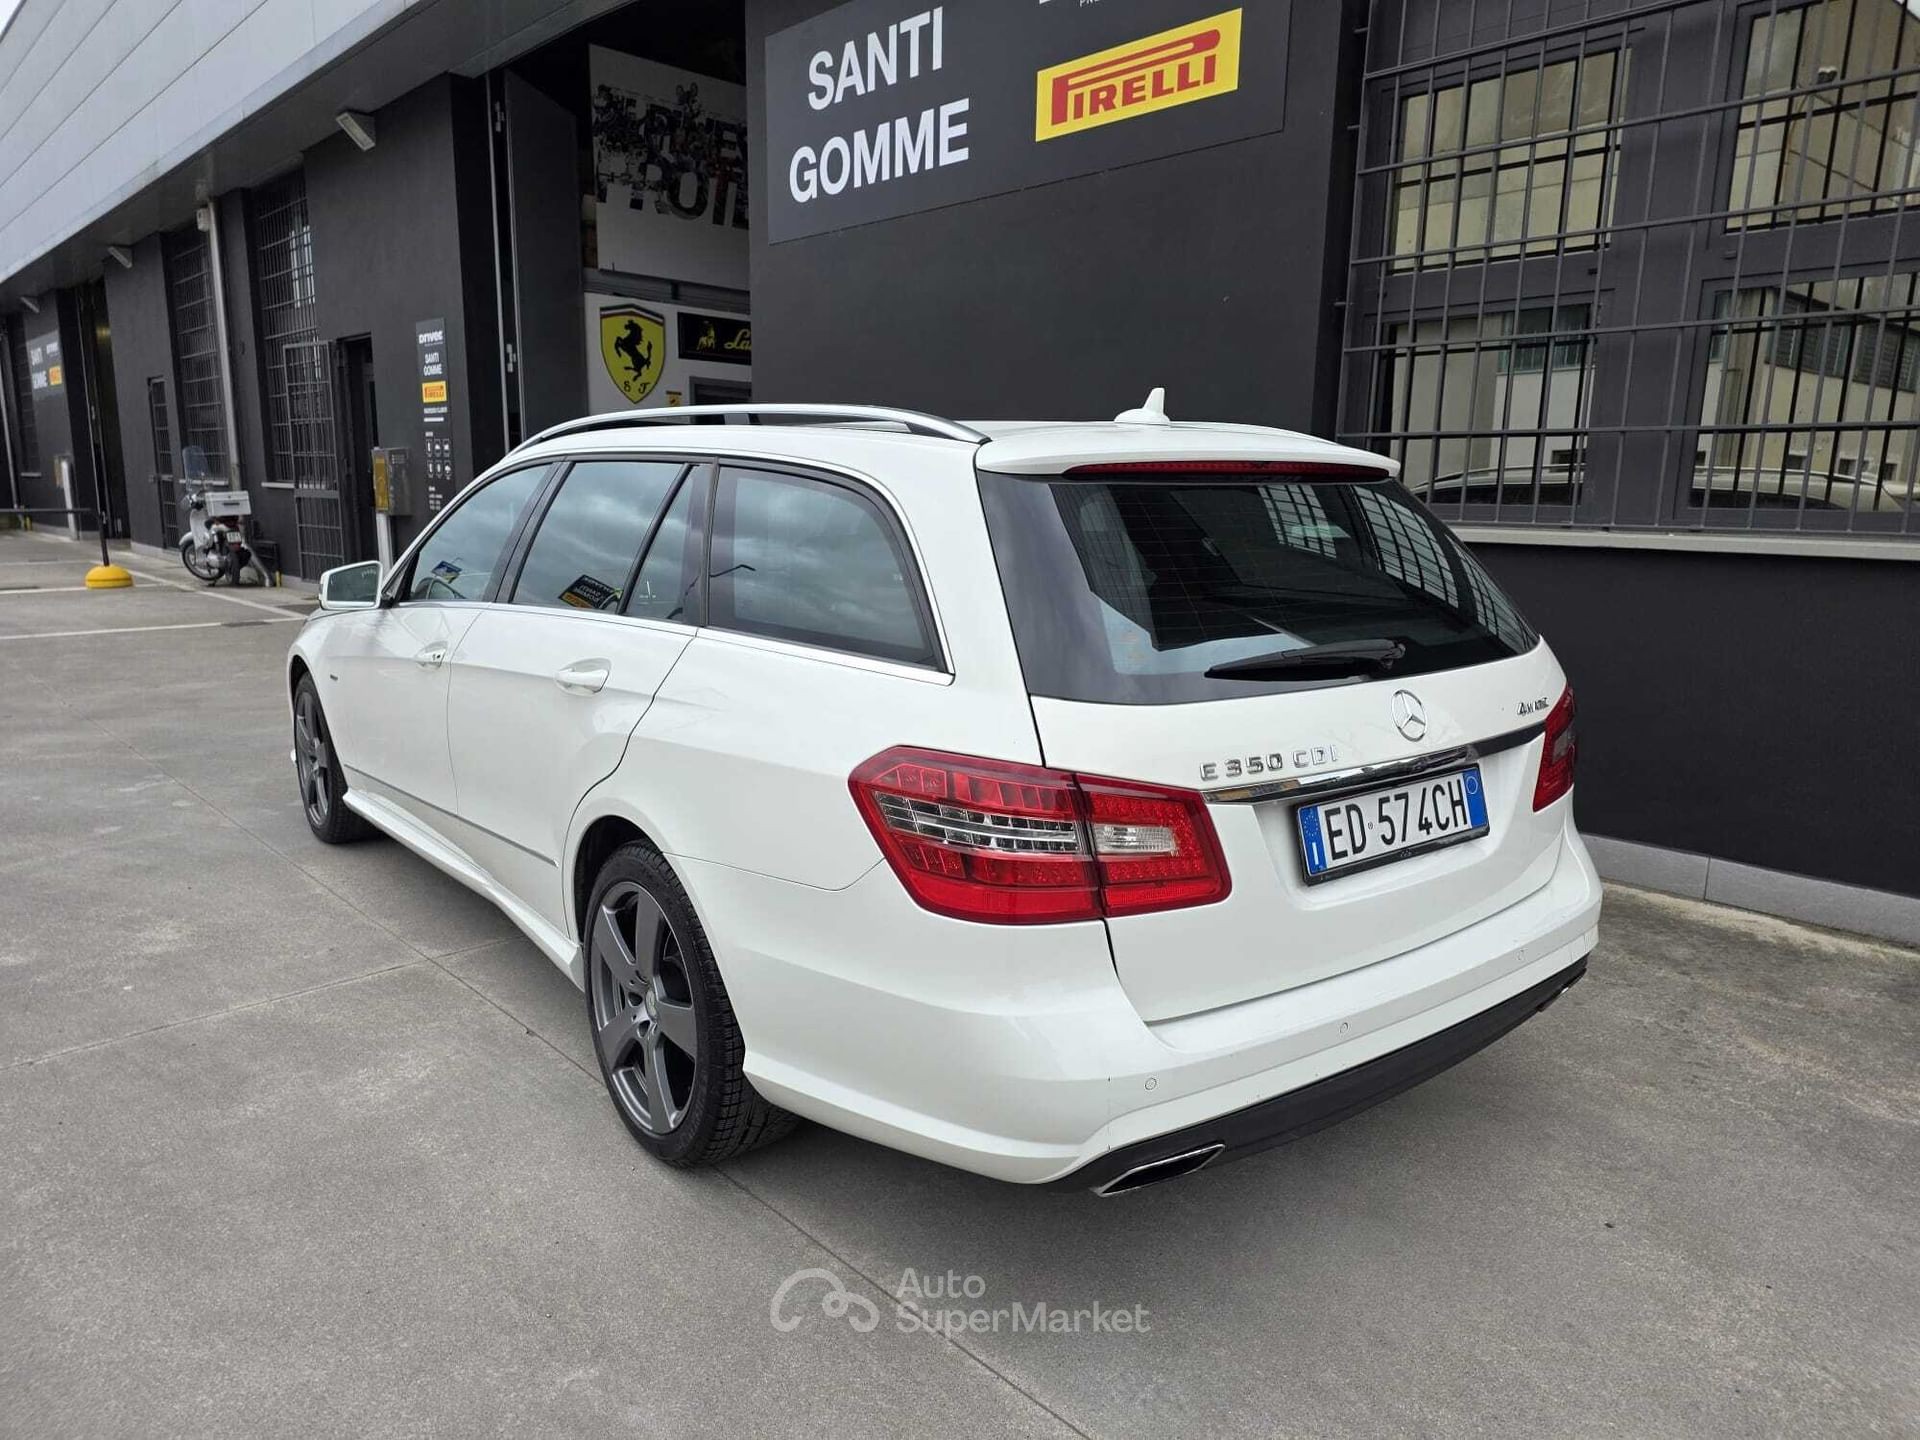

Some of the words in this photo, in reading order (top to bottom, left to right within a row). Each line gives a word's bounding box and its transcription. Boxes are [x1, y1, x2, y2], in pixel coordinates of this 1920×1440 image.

[807, 7, 943, 110] SANTI
[1051, 29, 1221, 125] PIRELLI
[789, 98, 969, 203] GOMME
[1200, 762, 1218, 781] E
[1224, 752, 1283, 778] 350
[1293, 744, 1339, 768] CDI
[1324, 802, 1367, 861] ED
[1378, 778, 1468, 846] 574CH
